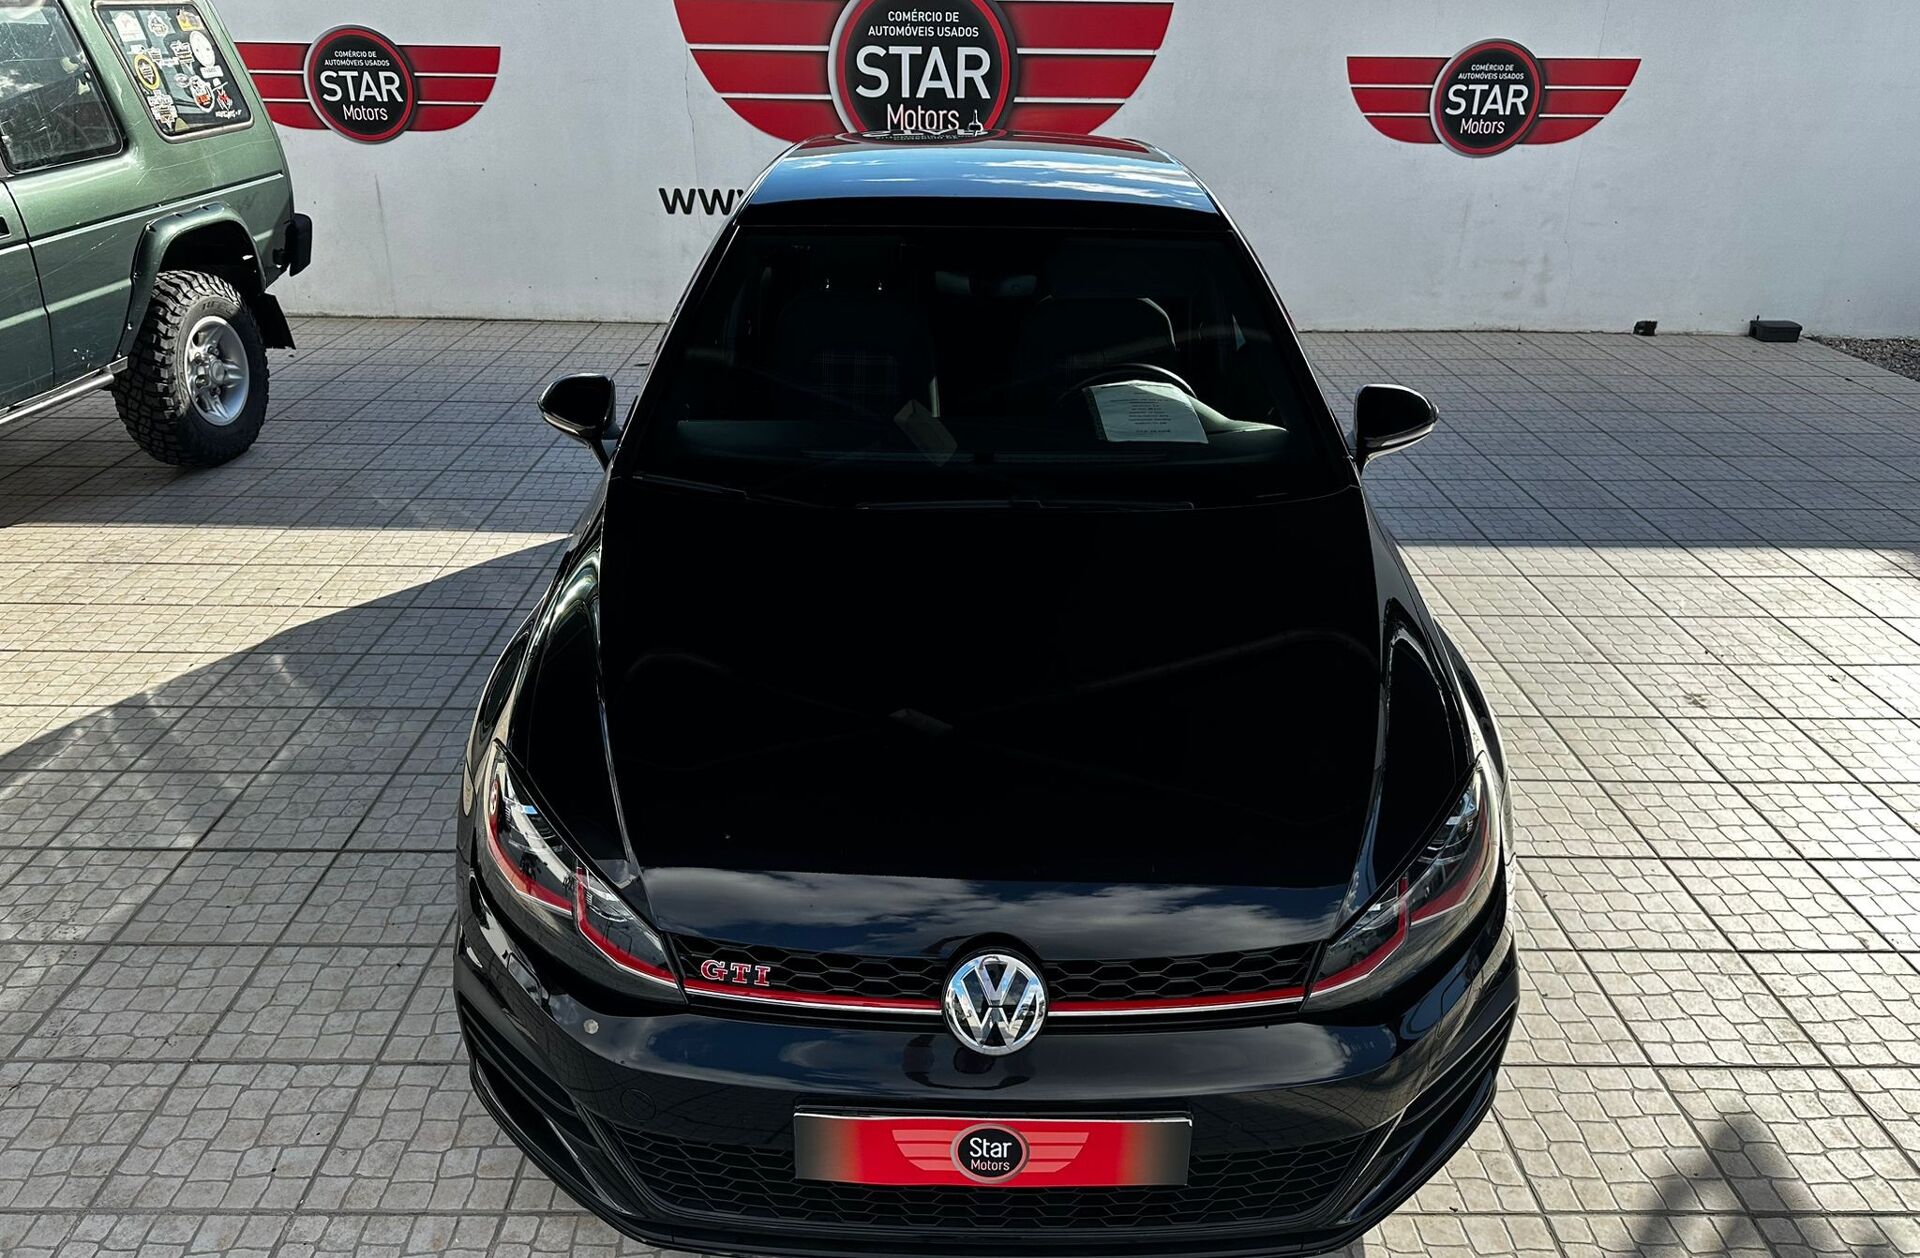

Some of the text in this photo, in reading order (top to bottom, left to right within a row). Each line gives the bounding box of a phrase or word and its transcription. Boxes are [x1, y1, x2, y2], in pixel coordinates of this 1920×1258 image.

[887, 9, 960, 23] COMÉRCIO DE
[868, 23, 980, 38] AUTOMÓVEIS USADOS
[334, 49, 377, 58] COMÉRCIO DE
[324, 58, 390, 67] AUTOMÓVEIS USADOS
[1471, 62, 1514, 72] COMÉRCIO DE
[855, 45, 992, 99] STAR
[1458, 71, 1498, 80] AUTOMÓVEIS
[320, 70, 404, 102] STAR
[1445, 84, 1529, 116] STAR
[342, 104, 389, 121] Motors
[887, 103, 960, 131] Motors
[1460, 117, 1506, 134] Motors
[658, 188, 744, 216] WW
[700, 959, 772, 987] GTI
[969, 1137, 1013, 1158] Star
[970, 1159, 1011, 1171] Motors
